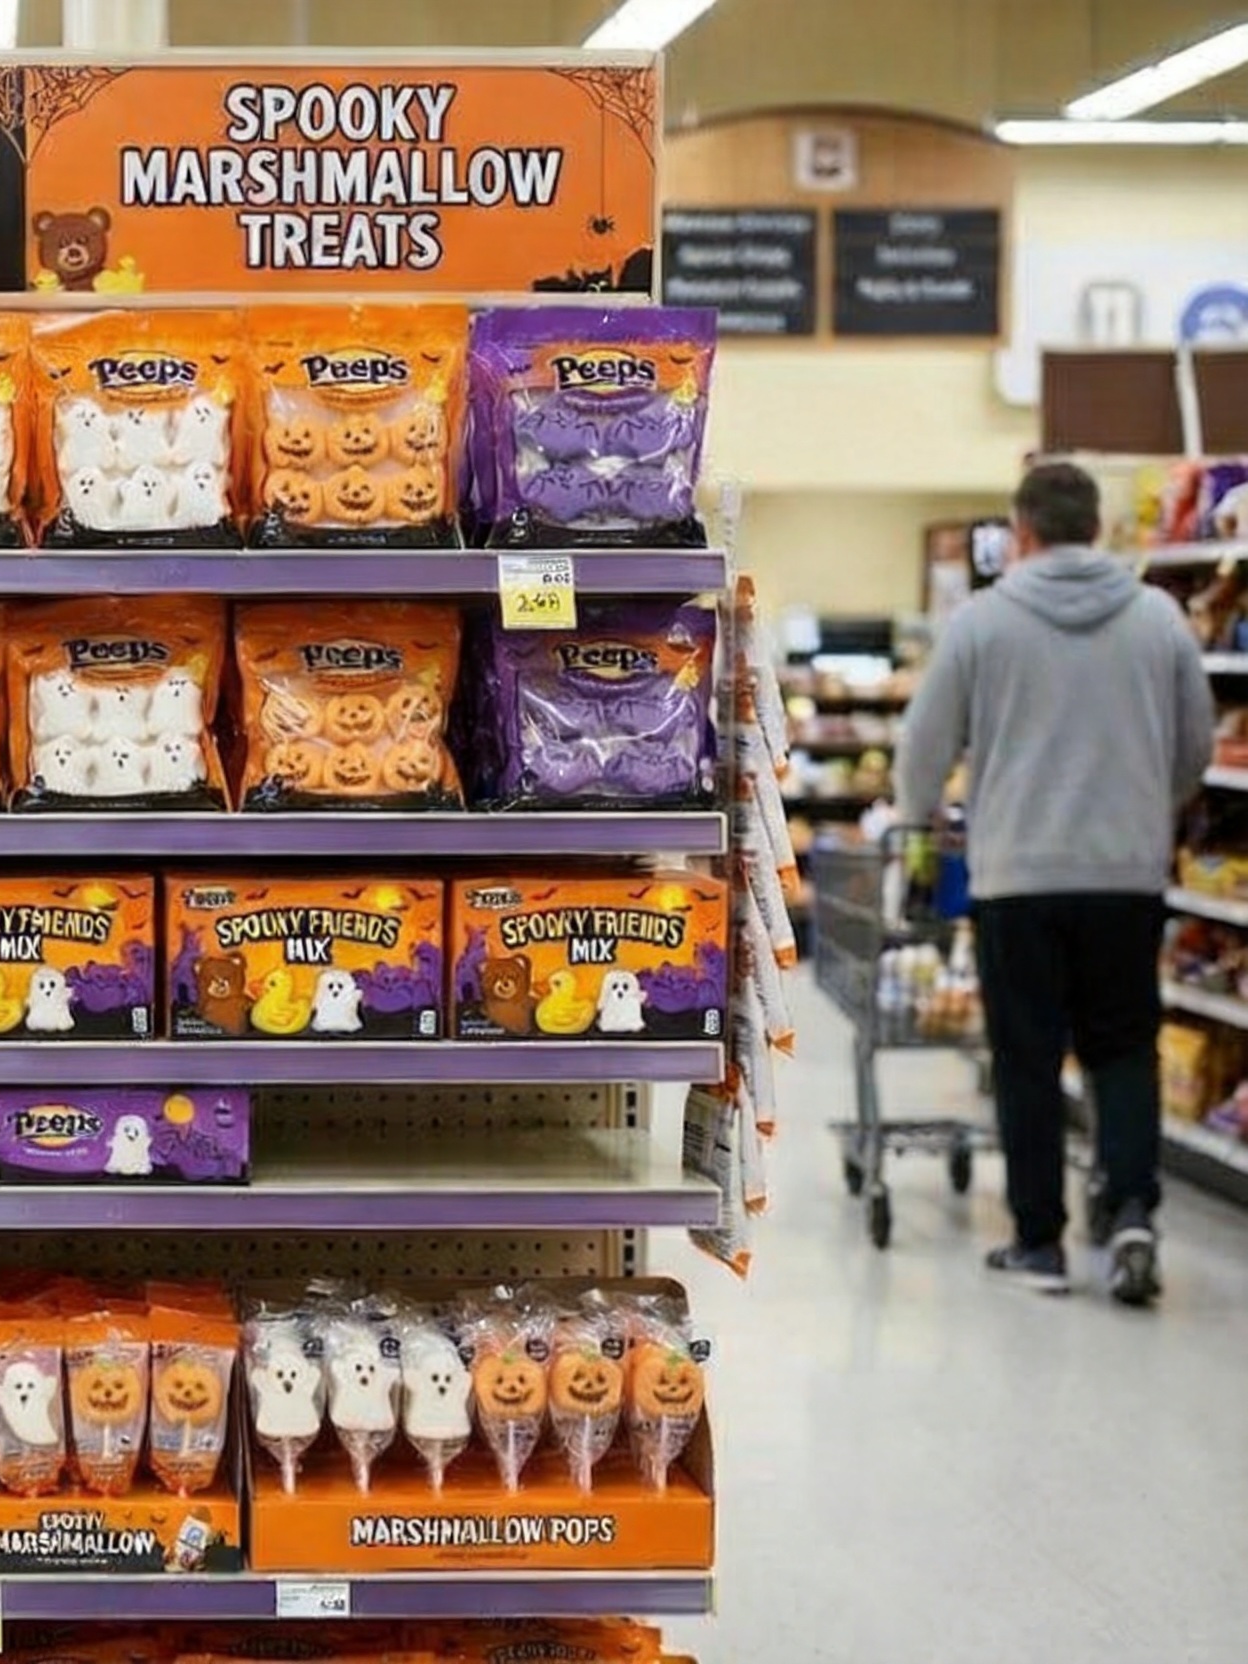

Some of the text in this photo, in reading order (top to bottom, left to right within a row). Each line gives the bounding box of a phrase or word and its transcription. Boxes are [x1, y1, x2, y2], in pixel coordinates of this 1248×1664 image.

[227, 84, 456, 143] SPOOKY
[122, 148, 562, 205] MARSHMALLOW
[240, 211, 443, 269] TREATS
[89, 357, 200, 388] Peeps
[302, 354, 408, 387] Peeps
[554, 357, 656, 389] Peeps
[572, 938, 613, 962] MIX
[351, 1517, 615, 1545] MARSHMALLOW POPS
